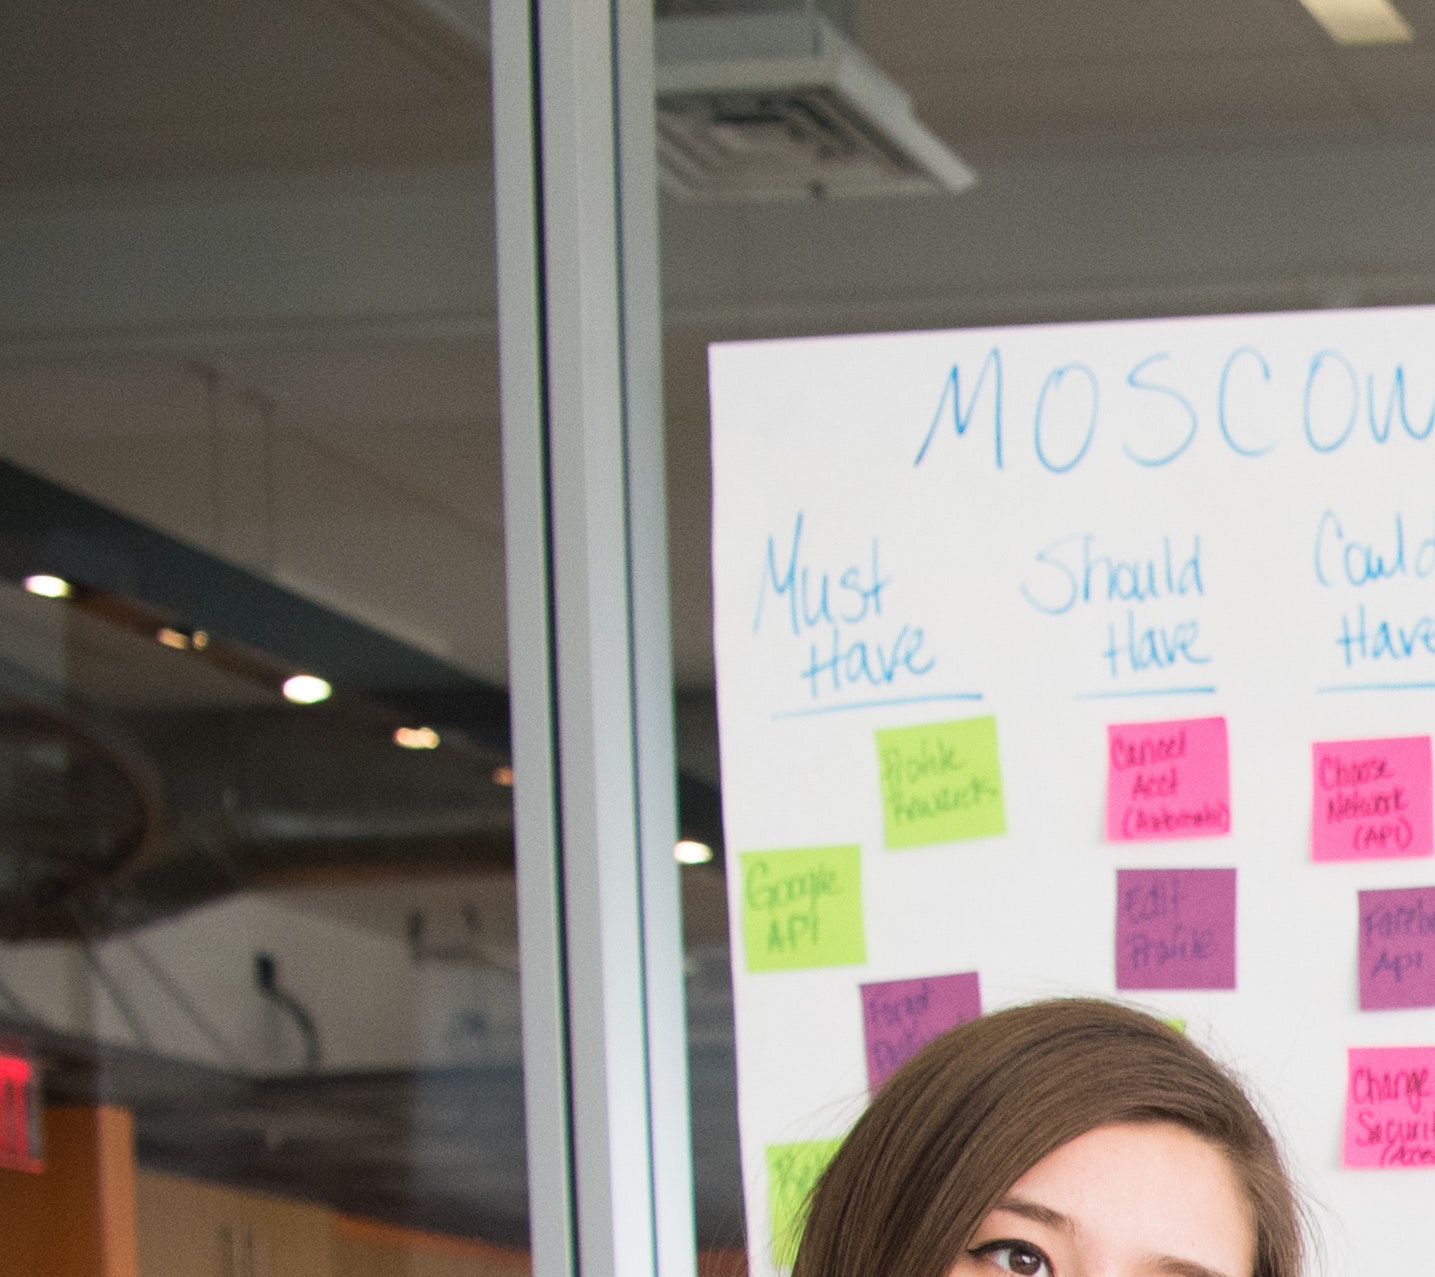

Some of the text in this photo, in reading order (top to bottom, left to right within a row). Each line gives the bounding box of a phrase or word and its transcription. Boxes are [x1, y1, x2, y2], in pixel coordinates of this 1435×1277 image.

[753, 512, 888, 638] Must
[1021, 533, 1204, 614] Should
[798, 621, 938, 698] Have
[1103, 612, 1213, 681] Have
[1110, 730, 1187, 772] Cancel
[1318, 753, 1394, 789] Choose
[745, 855, 845, 915] Google
[767, 913, 819, 953] API
[1352, 1064, 1430, 1114] Change
